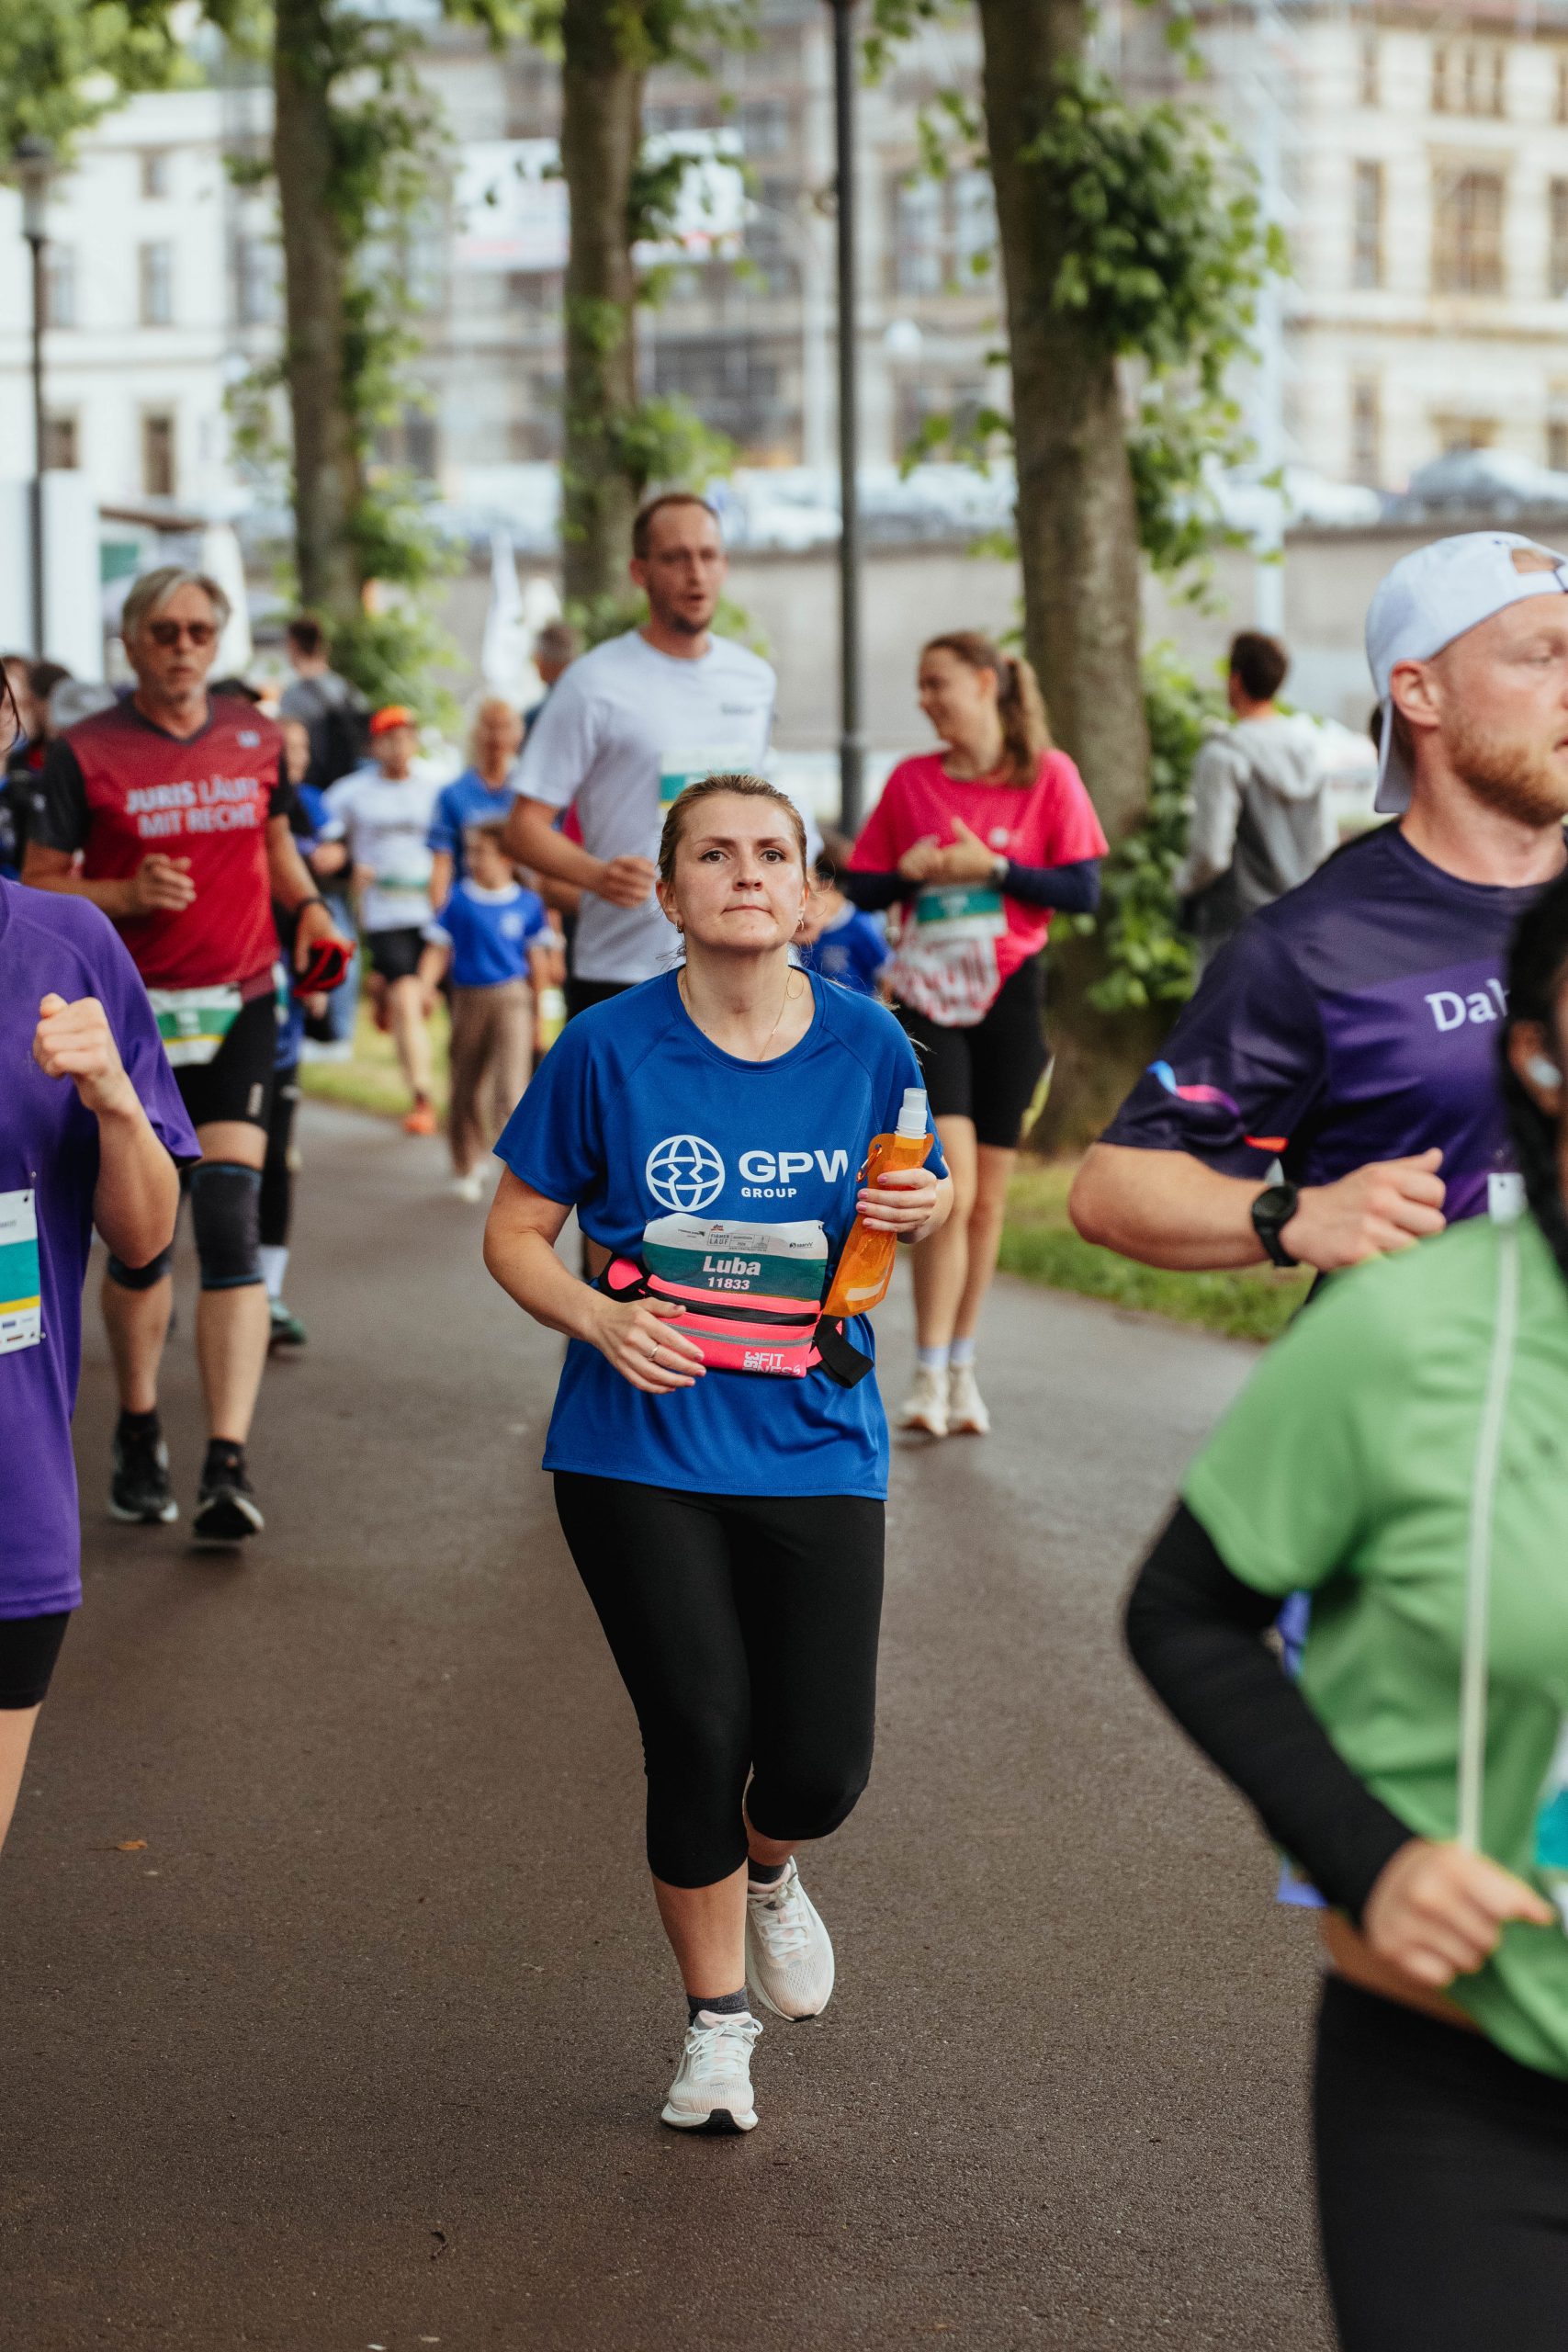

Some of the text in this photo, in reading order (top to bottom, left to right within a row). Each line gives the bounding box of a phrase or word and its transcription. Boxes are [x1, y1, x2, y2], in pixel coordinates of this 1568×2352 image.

[127, 782, 196, 815] JURIS
[139, 803, 256, 838] MIT RECHT
[739, 1149, 849, 1183] GPW
[740, 1187, 797, 1198] GROUP
[703, 1255, 761, 1276] Luba
[707, 1277, 750, 1290] 11833
[759, 1352, 785, 1367] FIT
